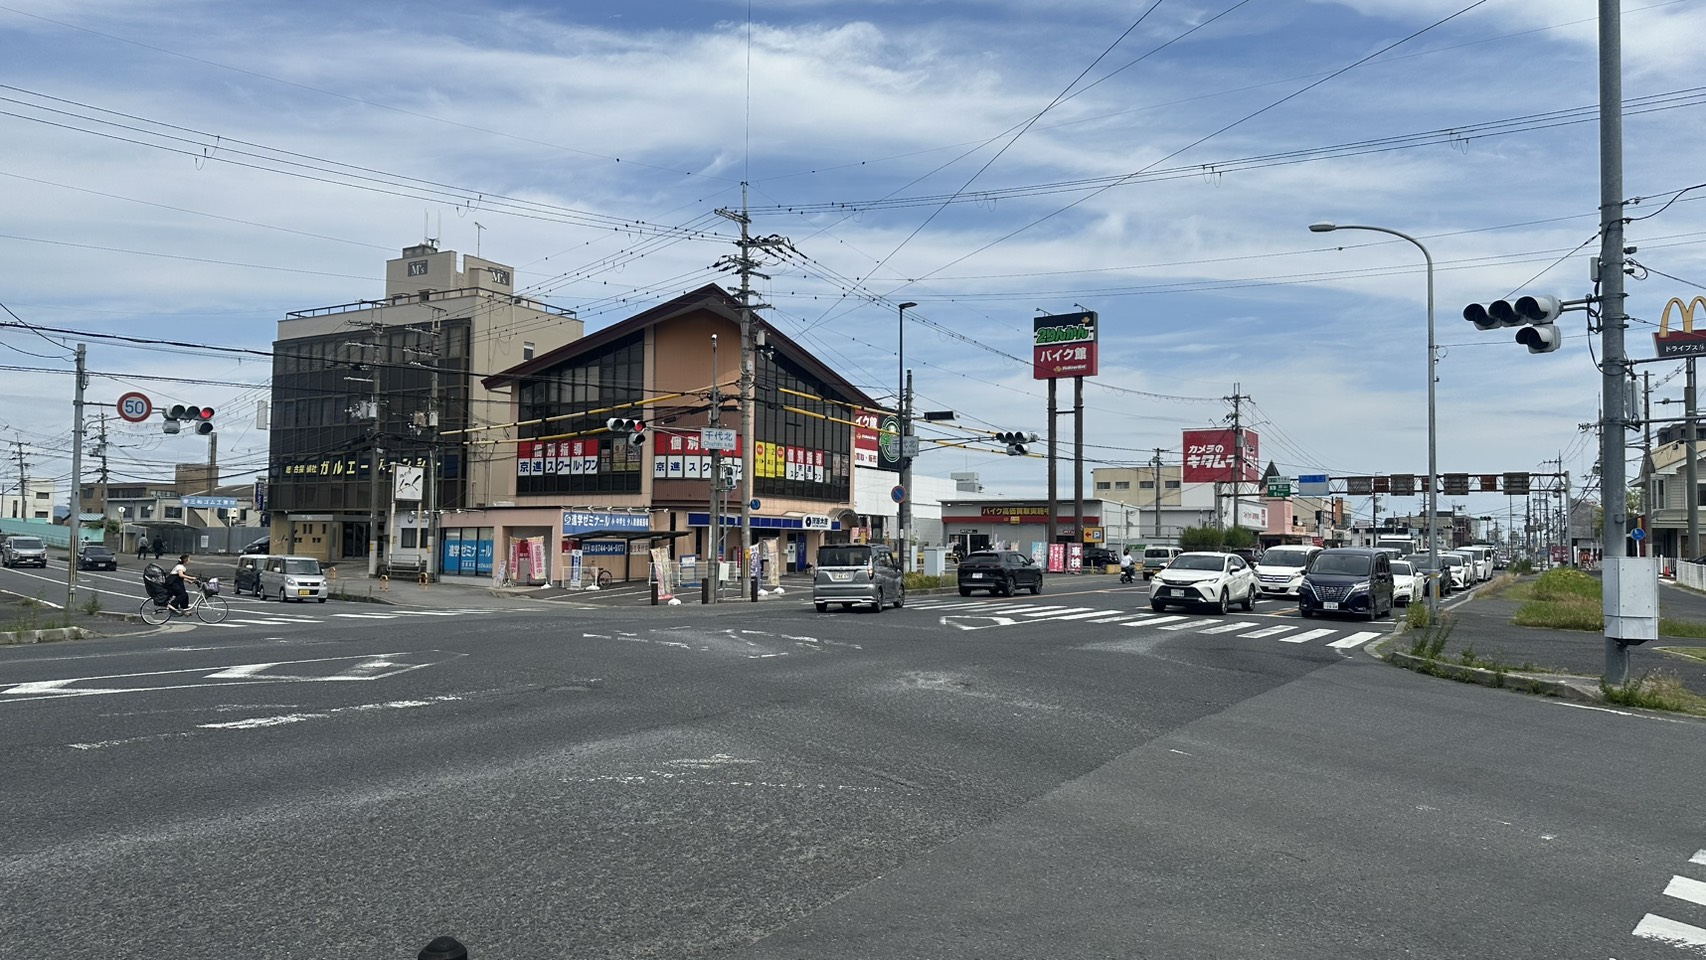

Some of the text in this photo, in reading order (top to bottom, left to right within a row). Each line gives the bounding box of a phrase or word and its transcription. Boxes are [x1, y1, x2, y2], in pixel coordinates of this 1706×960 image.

[1036, 325, 1089, 343] 2りんかん
[1040, 347, 1087, 362] バイク館
[125, 400, 144, 415] 50
[704, 430, 733, 441] 千代北
[533, 442, 583, 457] 個別指導
[787, 448, 822, 465] 個別指導
[1188, 444, 1224, 454] カメラの
[519, 460, 598, 473] 京進スクール・ワン
[1187, 454, 1240, 468] キタムラ
[1071, 547, 1081, 569] 車検
